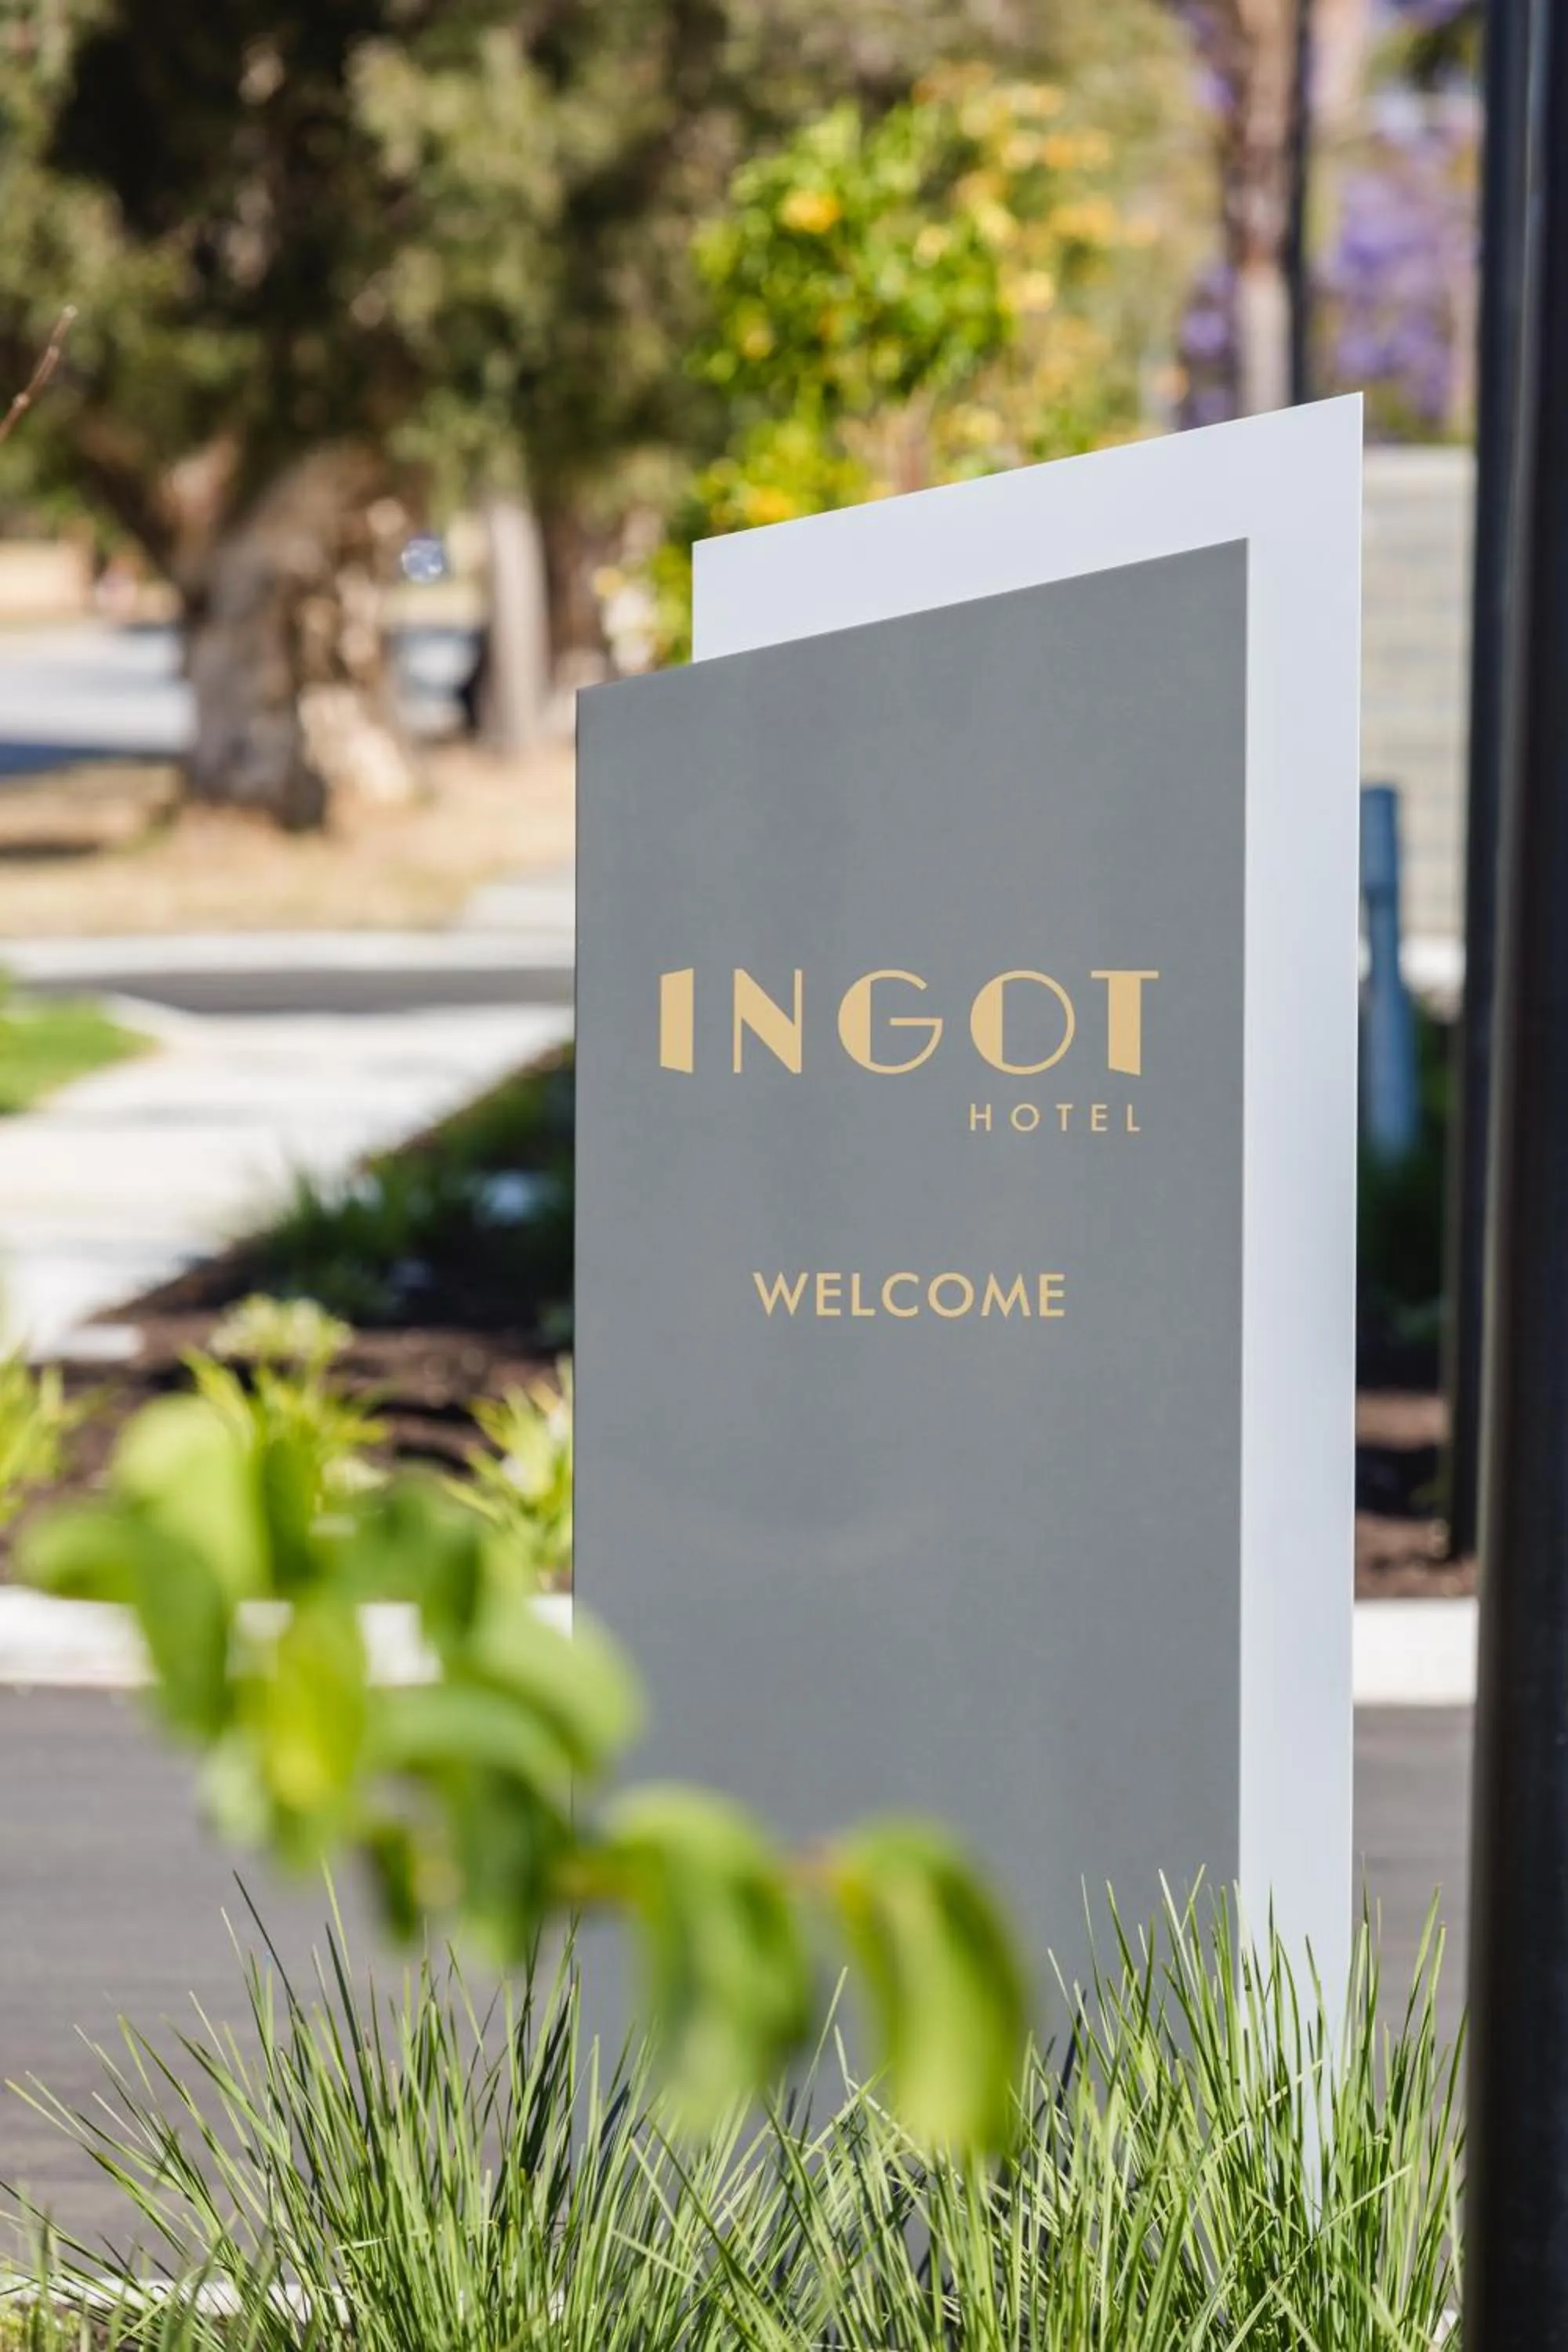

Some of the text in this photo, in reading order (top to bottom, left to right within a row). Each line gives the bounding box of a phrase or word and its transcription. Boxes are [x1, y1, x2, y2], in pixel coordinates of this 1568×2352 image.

[659, 968, 1160, 1076] INGOT
[970, 1103, 1142, 1132] HOTEL
[753, 1272, 1066, 1319] WELCOME
